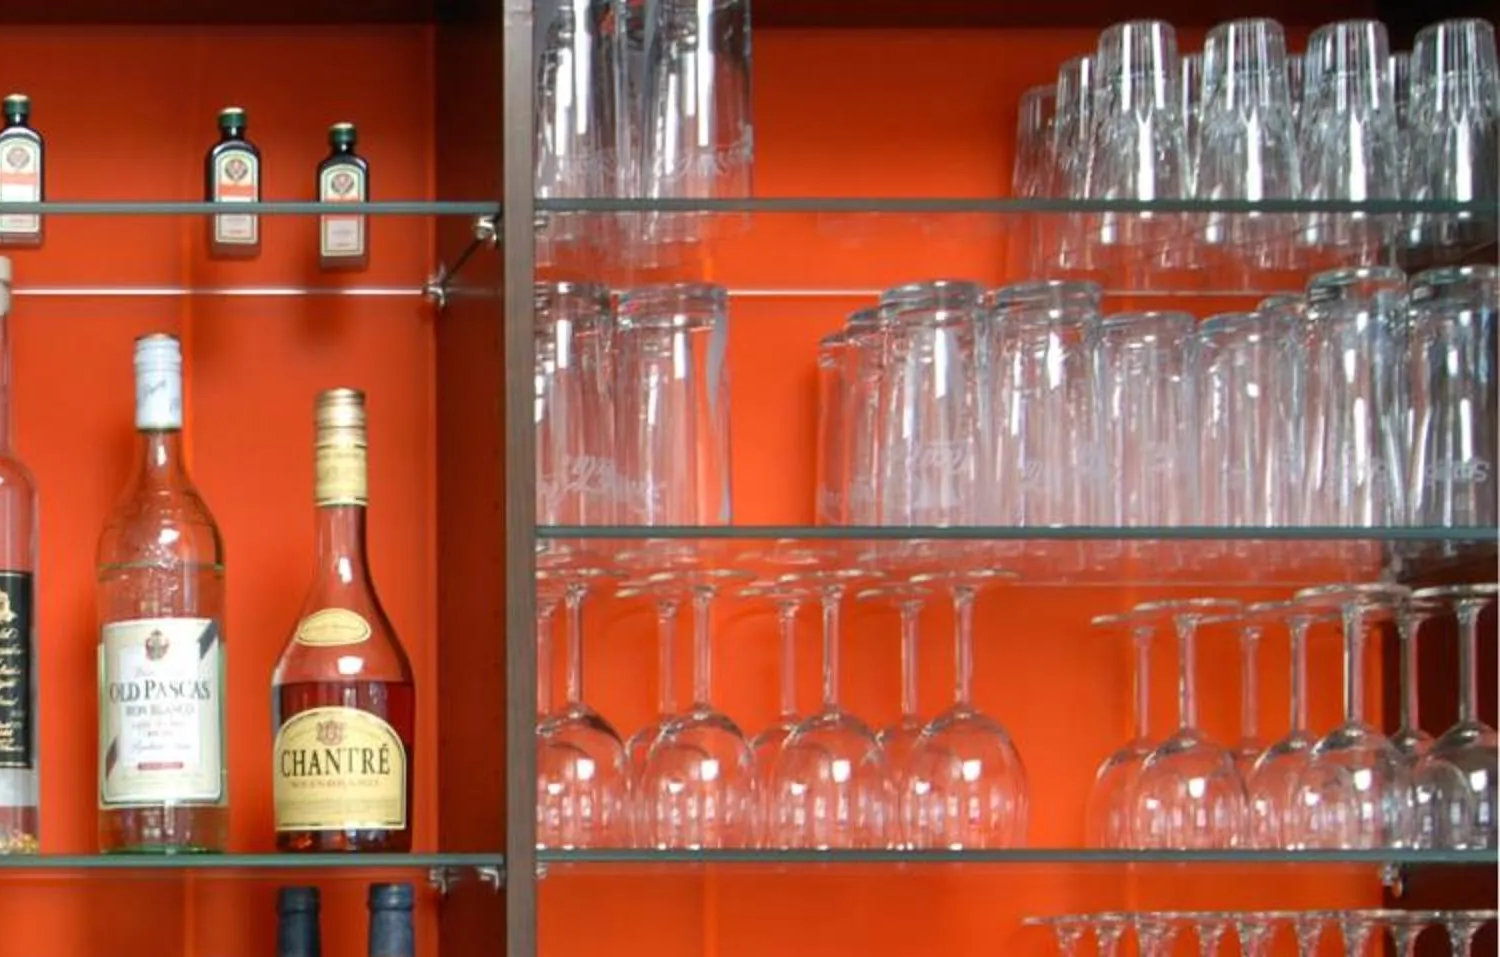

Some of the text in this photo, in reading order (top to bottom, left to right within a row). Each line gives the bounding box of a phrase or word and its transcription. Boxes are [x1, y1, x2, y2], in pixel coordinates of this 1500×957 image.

[109, 679, 211, 703] OLD PASCAS
[280, 743, 391, 777] CHANTRÉ
